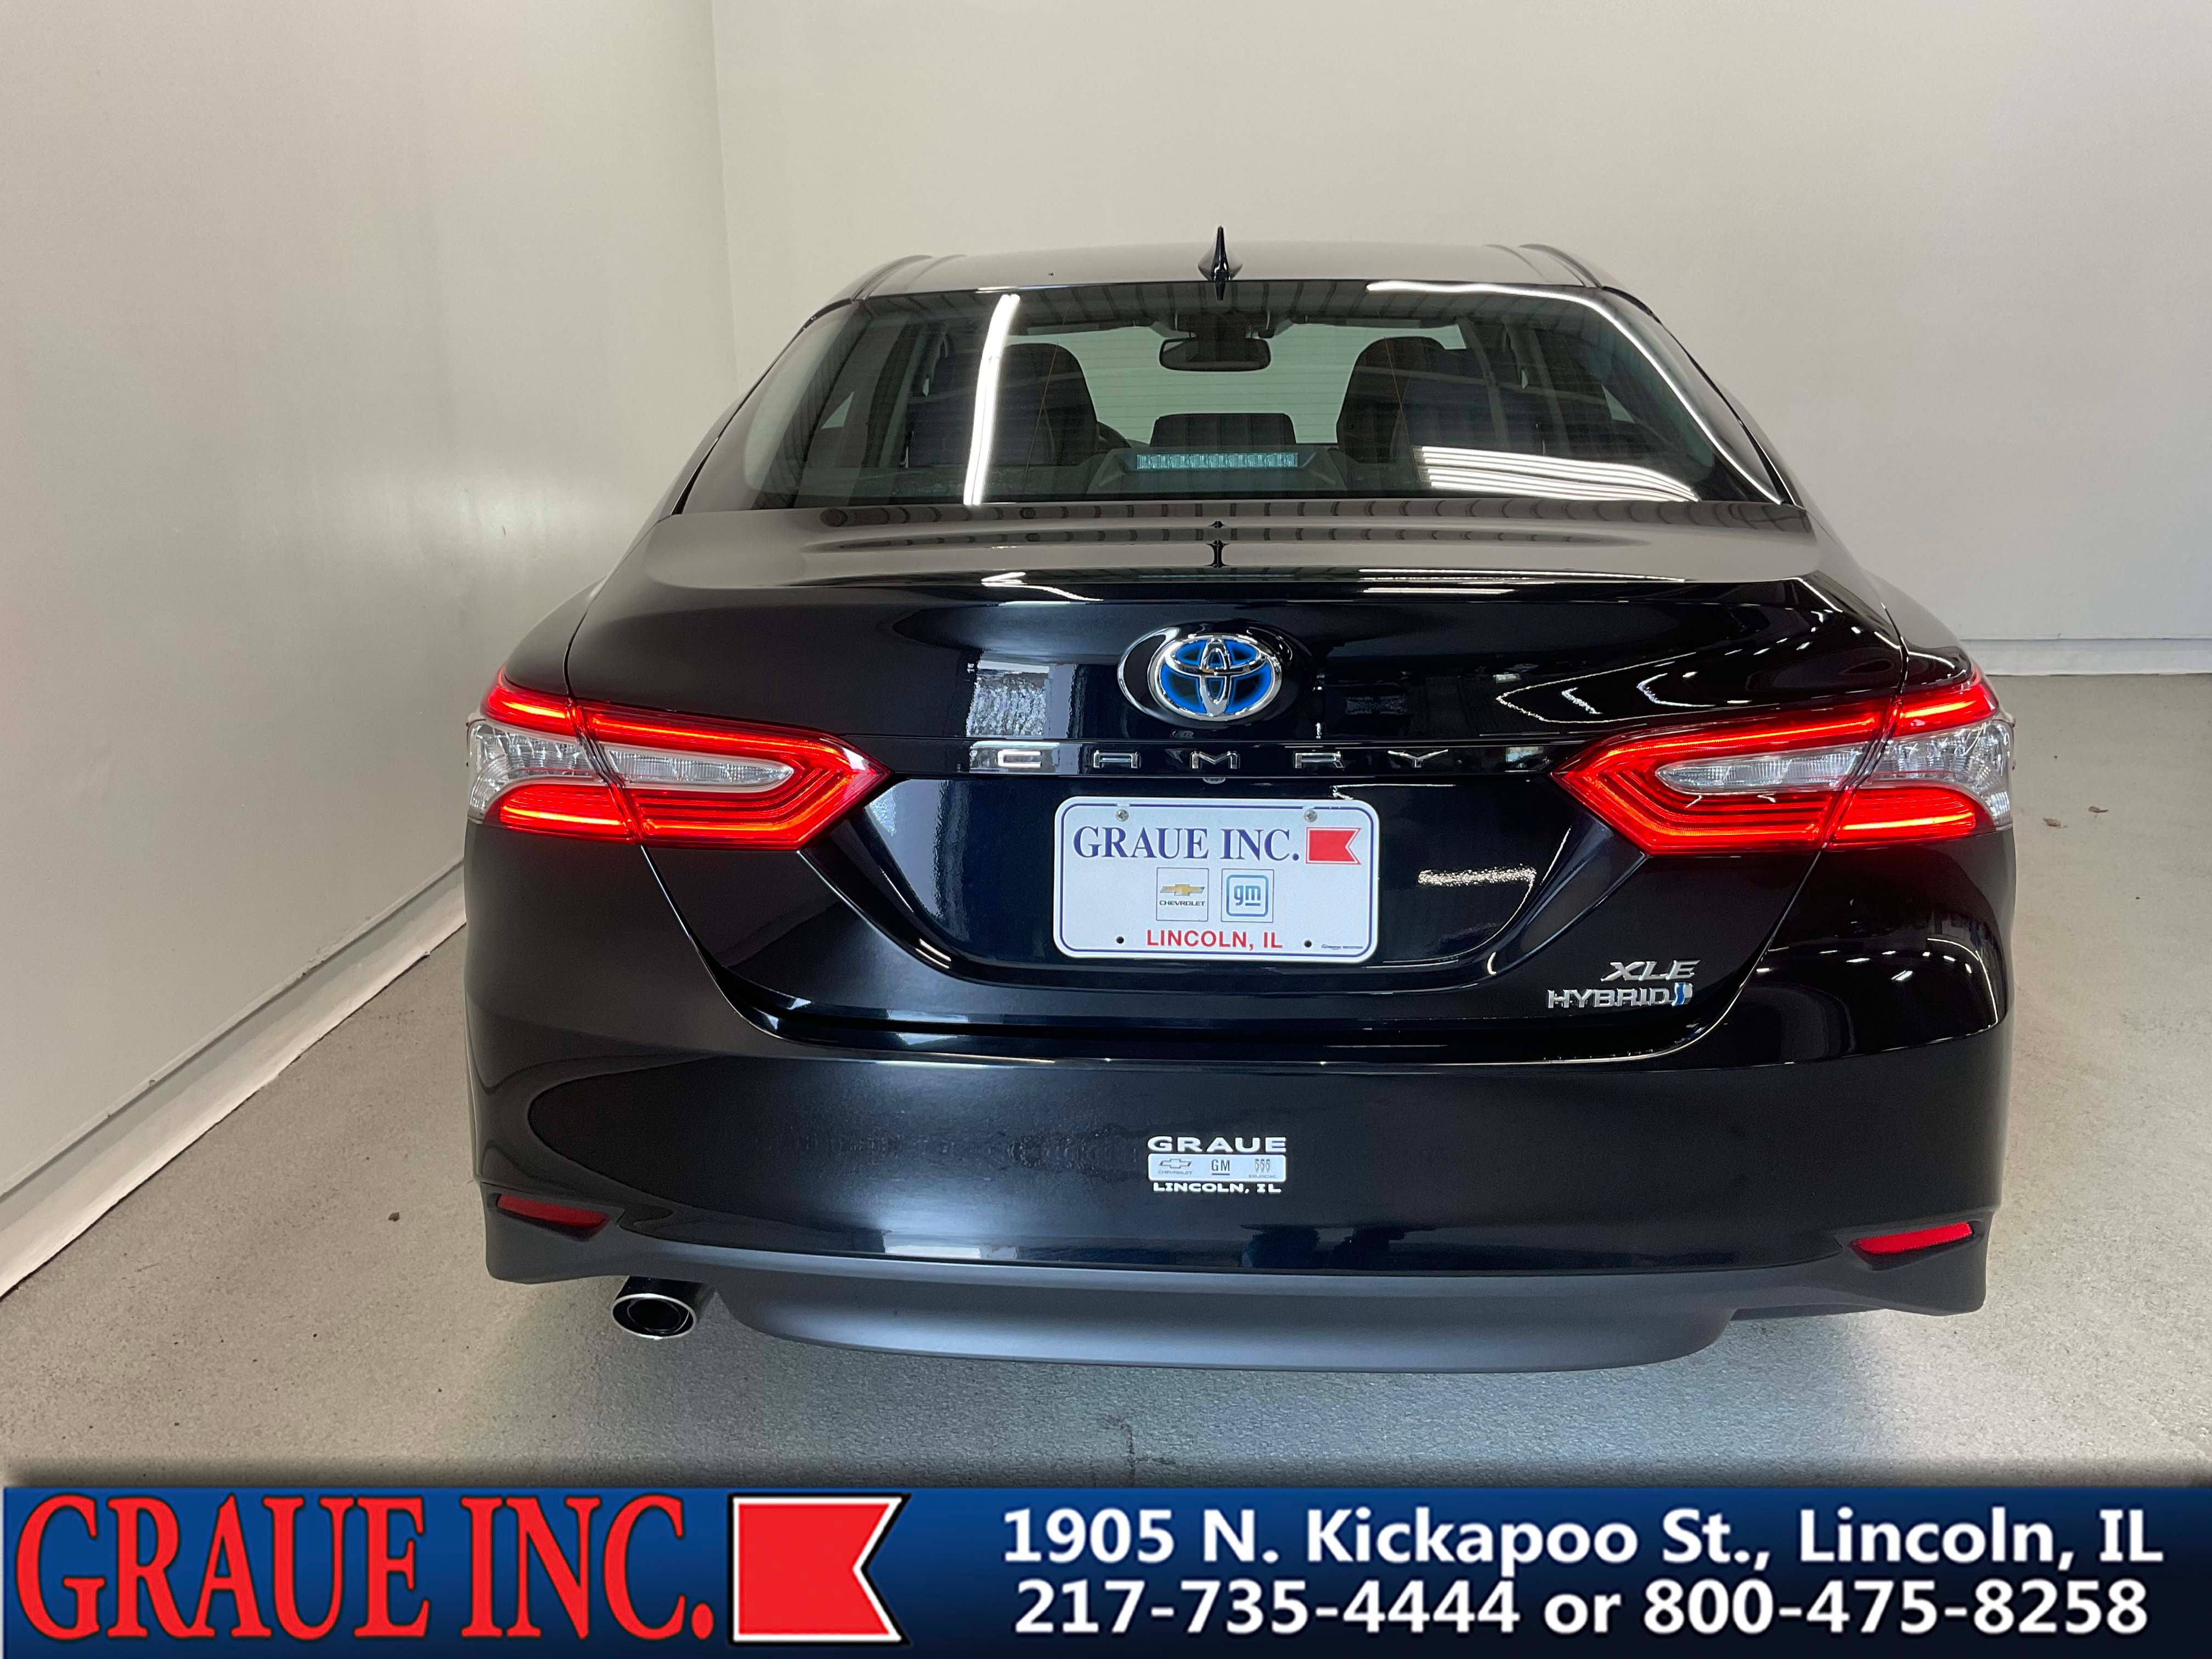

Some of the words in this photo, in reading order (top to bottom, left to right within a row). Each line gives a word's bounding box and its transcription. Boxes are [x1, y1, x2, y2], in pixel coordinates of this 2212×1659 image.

[997, 748, 1448, 769] CAMRY
[1073, 826, 1209, 859] GRAUE
[1220, 828, 1300, 861] INC.
[1234, 885, 1261, 906] gm
[1147, 929, 1255, 951] LINCOLN,
[1263, 932, 1283, 949] IL
[1600, 960, 1700, 981] XLE
[1548, 988, 1672, 1008] HYBRID
[1148, 1136, 1286, 1153] GRAUE
[1211, 1159, 1230, 1172] GM
[1153, 1182, 1250, 1193] LINCOLN,
[1256, 1183, 1282, 1193] IL
